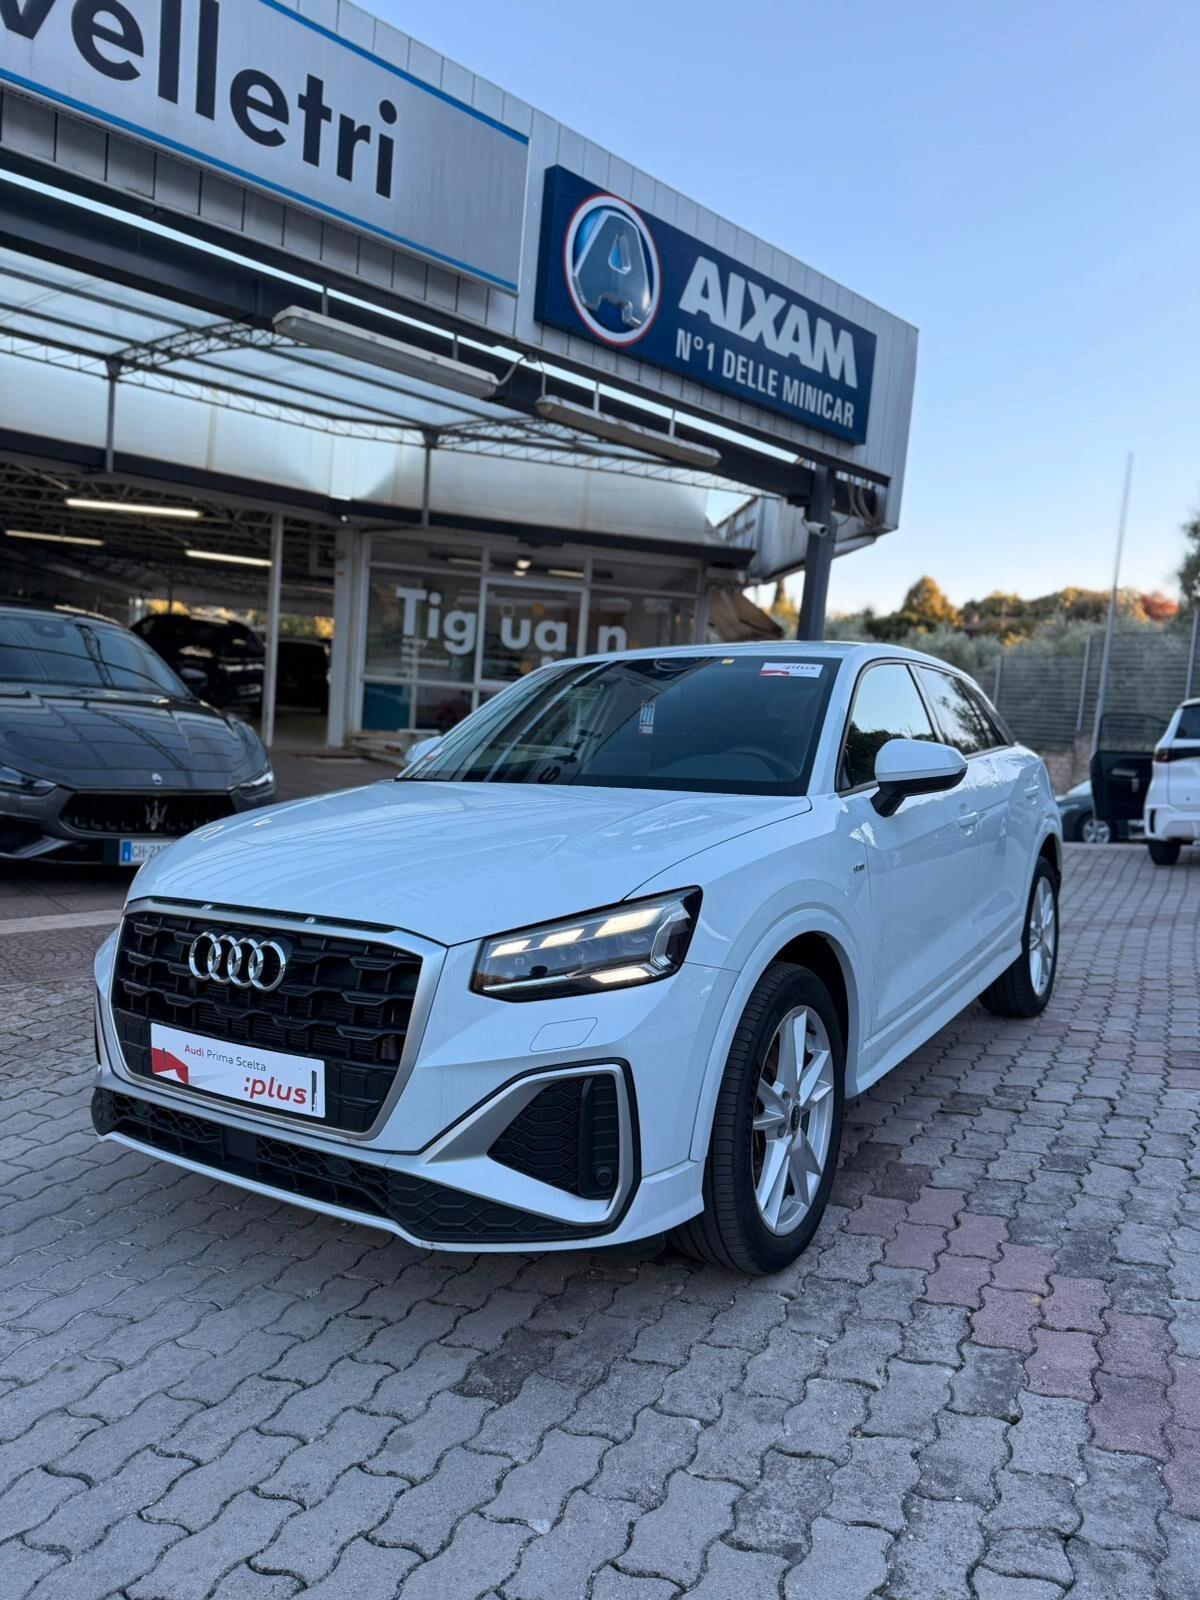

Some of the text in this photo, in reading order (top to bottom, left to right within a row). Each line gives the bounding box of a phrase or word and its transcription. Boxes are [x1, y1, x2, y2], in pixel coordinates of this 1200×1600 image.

[678, 255, 858, 390] AIXAM
[723, 349, 777, 398] DELLE
[783, 375, 855, 429] MINICAR
[184, 1044, 267, 1072] Audi Prima Scelta
